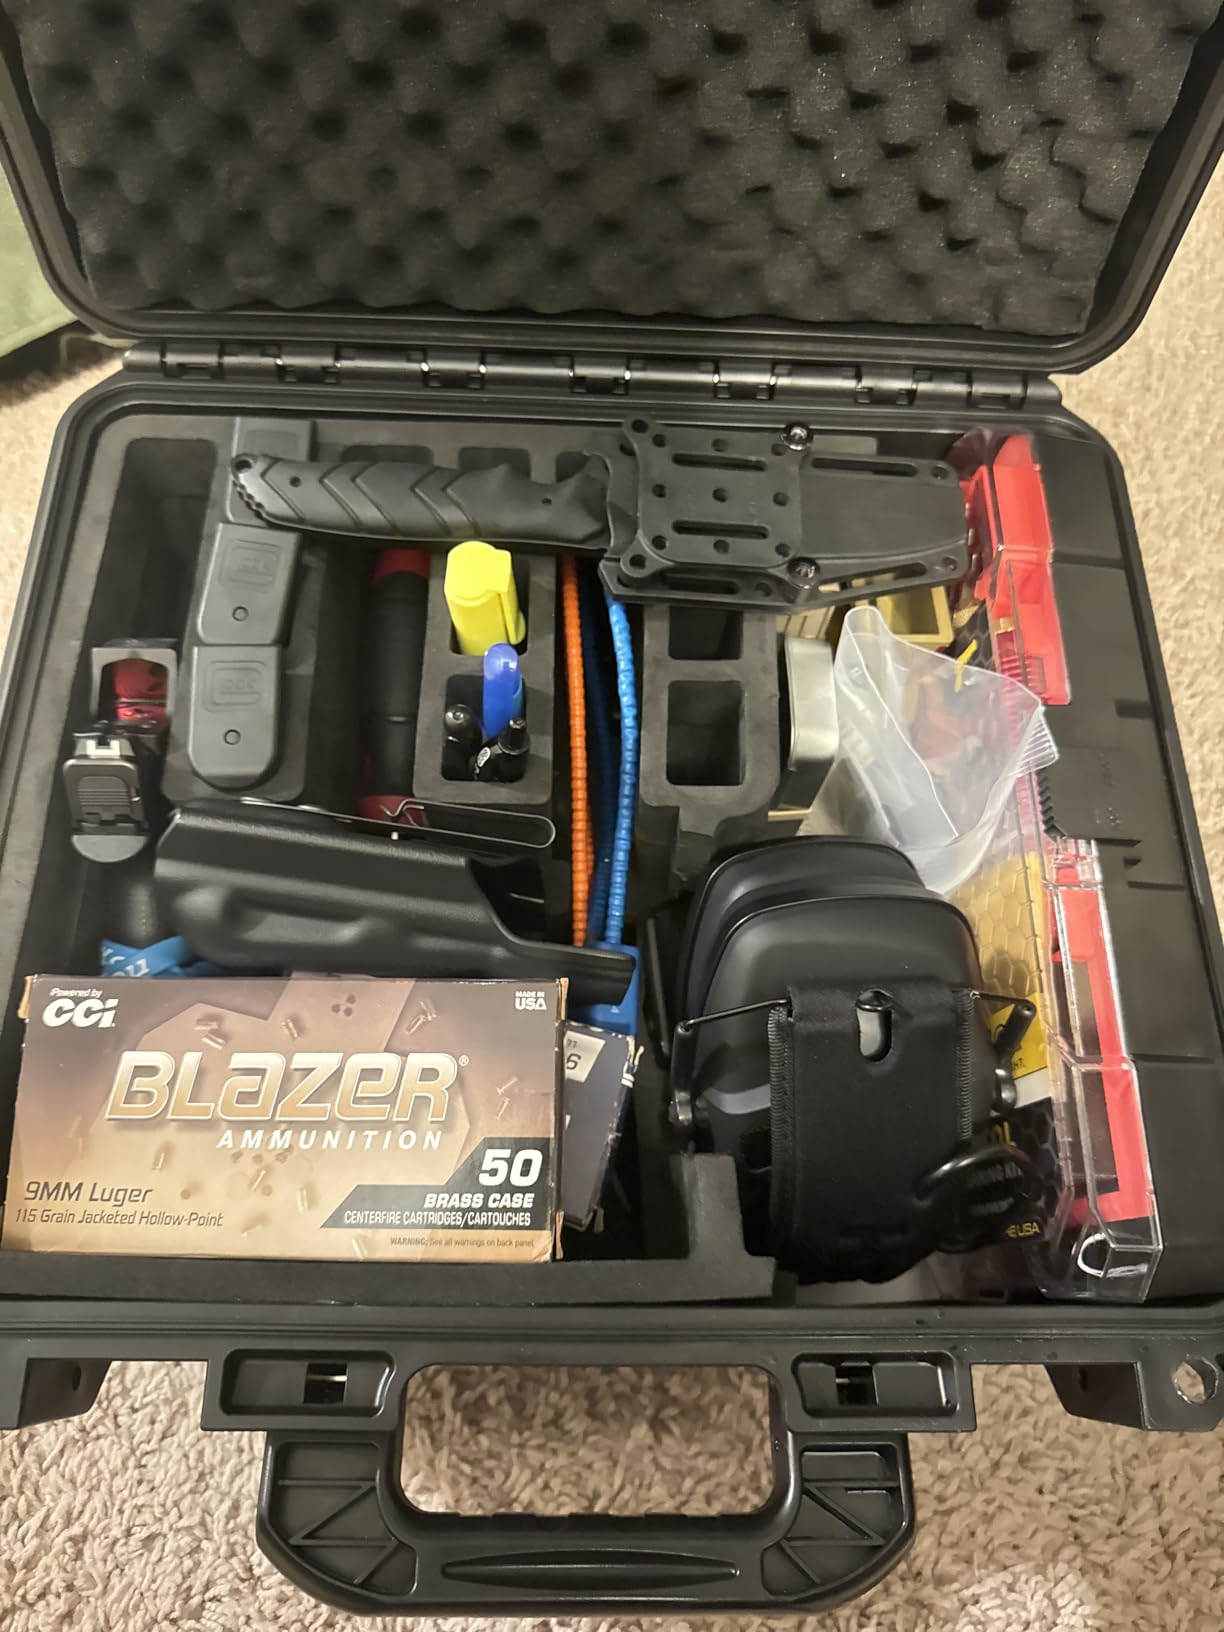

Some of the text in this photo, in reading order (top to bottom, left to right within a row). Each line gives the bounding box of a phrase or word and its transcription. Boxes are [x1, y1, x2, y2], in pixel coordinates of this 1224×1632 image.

[49, 987, 104, 998] Powered by
[515, 997, 547, 1011] USA
[216, 1129, 443, 1150] AMMUNITION
[478, 1148, 543, 1187] 50
[24, 1181, 153, 1207] 9MM Luger
[424, 1193, 535, 1208] BRASS CASE
[16, 1208, 224, 1227] 115 Grain Jacketed Hollow-Point
[344, 1210, 531, 1228] CENTERFIRE CARTRIDGES/CARTOUCHES
[430, 1237, 443, 1247] See
[445, 1237, 453, 1247] all
[453, 1238, 486, 1249] warnings
[486, 1239, 496, 1247] on
[497, 1238, 513, 1248] back
